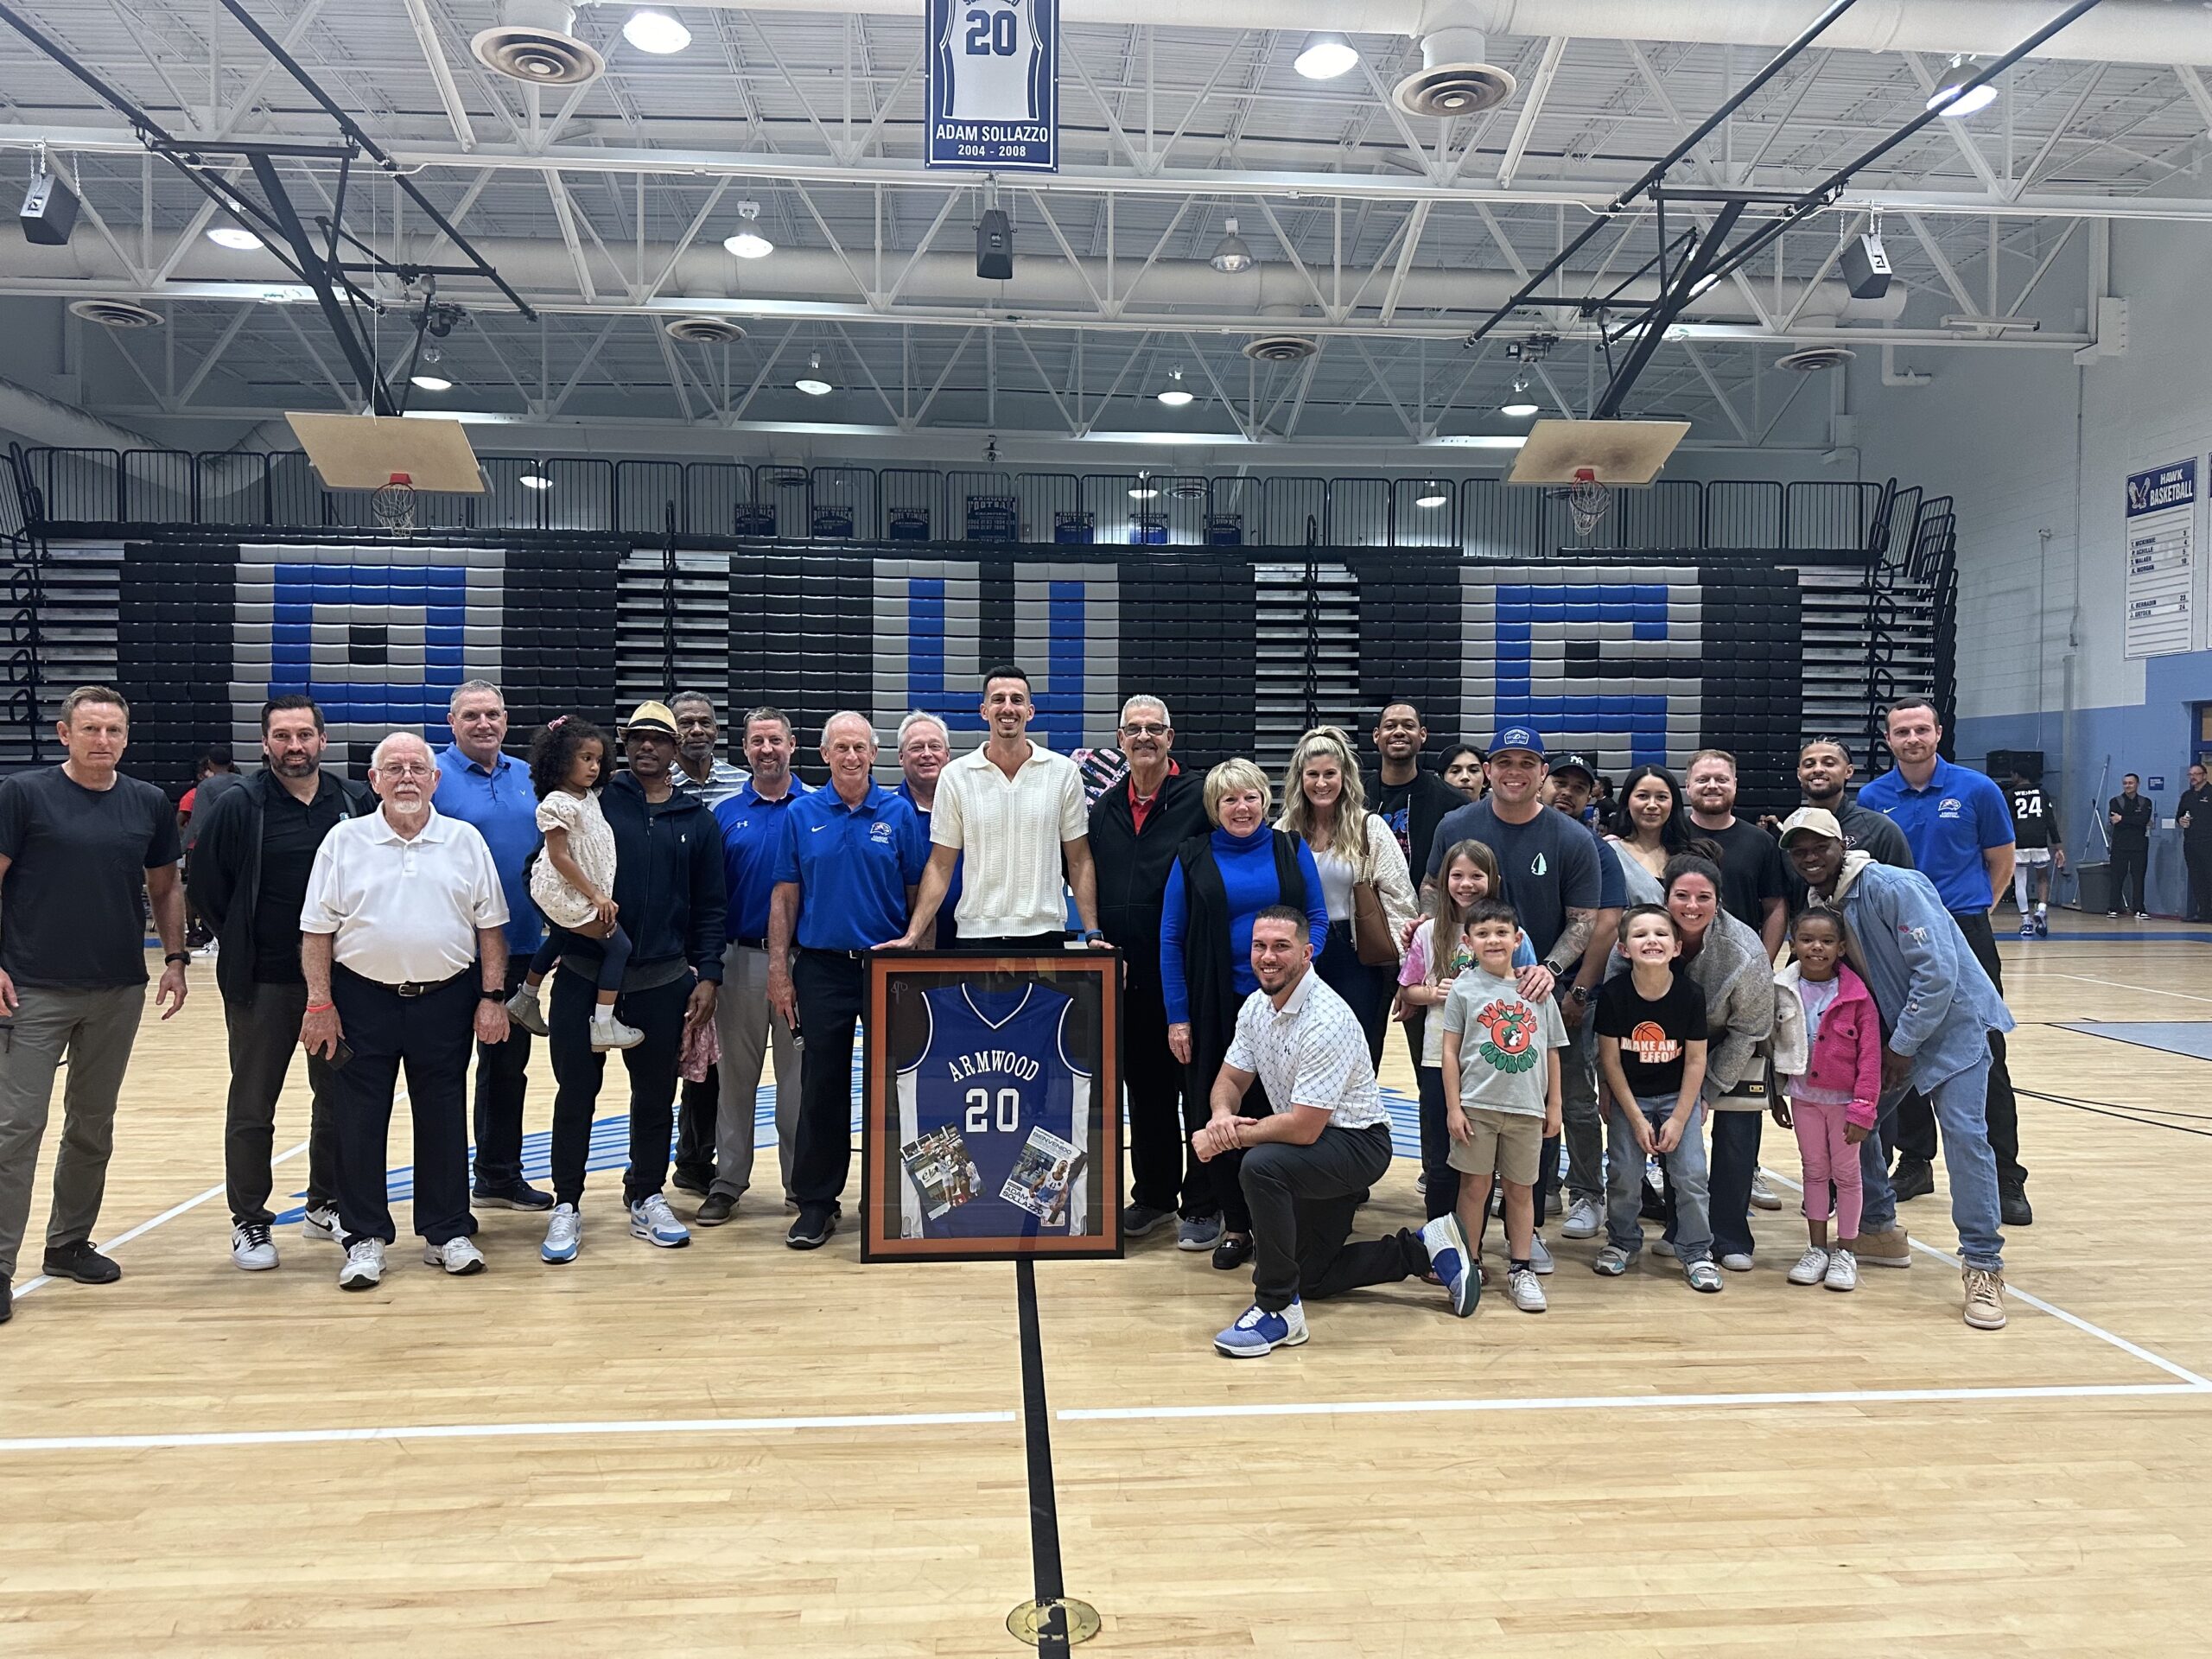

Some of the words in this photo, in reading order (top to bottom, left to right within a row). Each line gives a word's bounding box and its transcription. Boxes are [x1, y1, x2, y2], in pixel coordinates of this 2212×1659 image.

[966, 10, 1017, 56] 20
[936, 124, 977, 141] ADAM
[982, 125, 1048, 143] SOLLAZZO
[957, 144, 985, 156] 2004
[998, 145, 1027, 157] 2008
[2160, 468, 2183, 485] HAWK
[2150, 480, 2193, 506] BASKETBALL
[2015, 796, 2043, 819] 24
[1621, 1037, 1656, 1052] MAKE
[1658, 1040, 1675, 1052] AN
[948, 1049, 1039, 1083] ARMWOOD
[1479, 1041, 1538, 1074] GEORGIA
[965, 1088, 1020, 1132] 20
[1002, 1191, 1044, 1215] SOLLAZZO
[1004, 1185, 1029, 1201] ADAM
